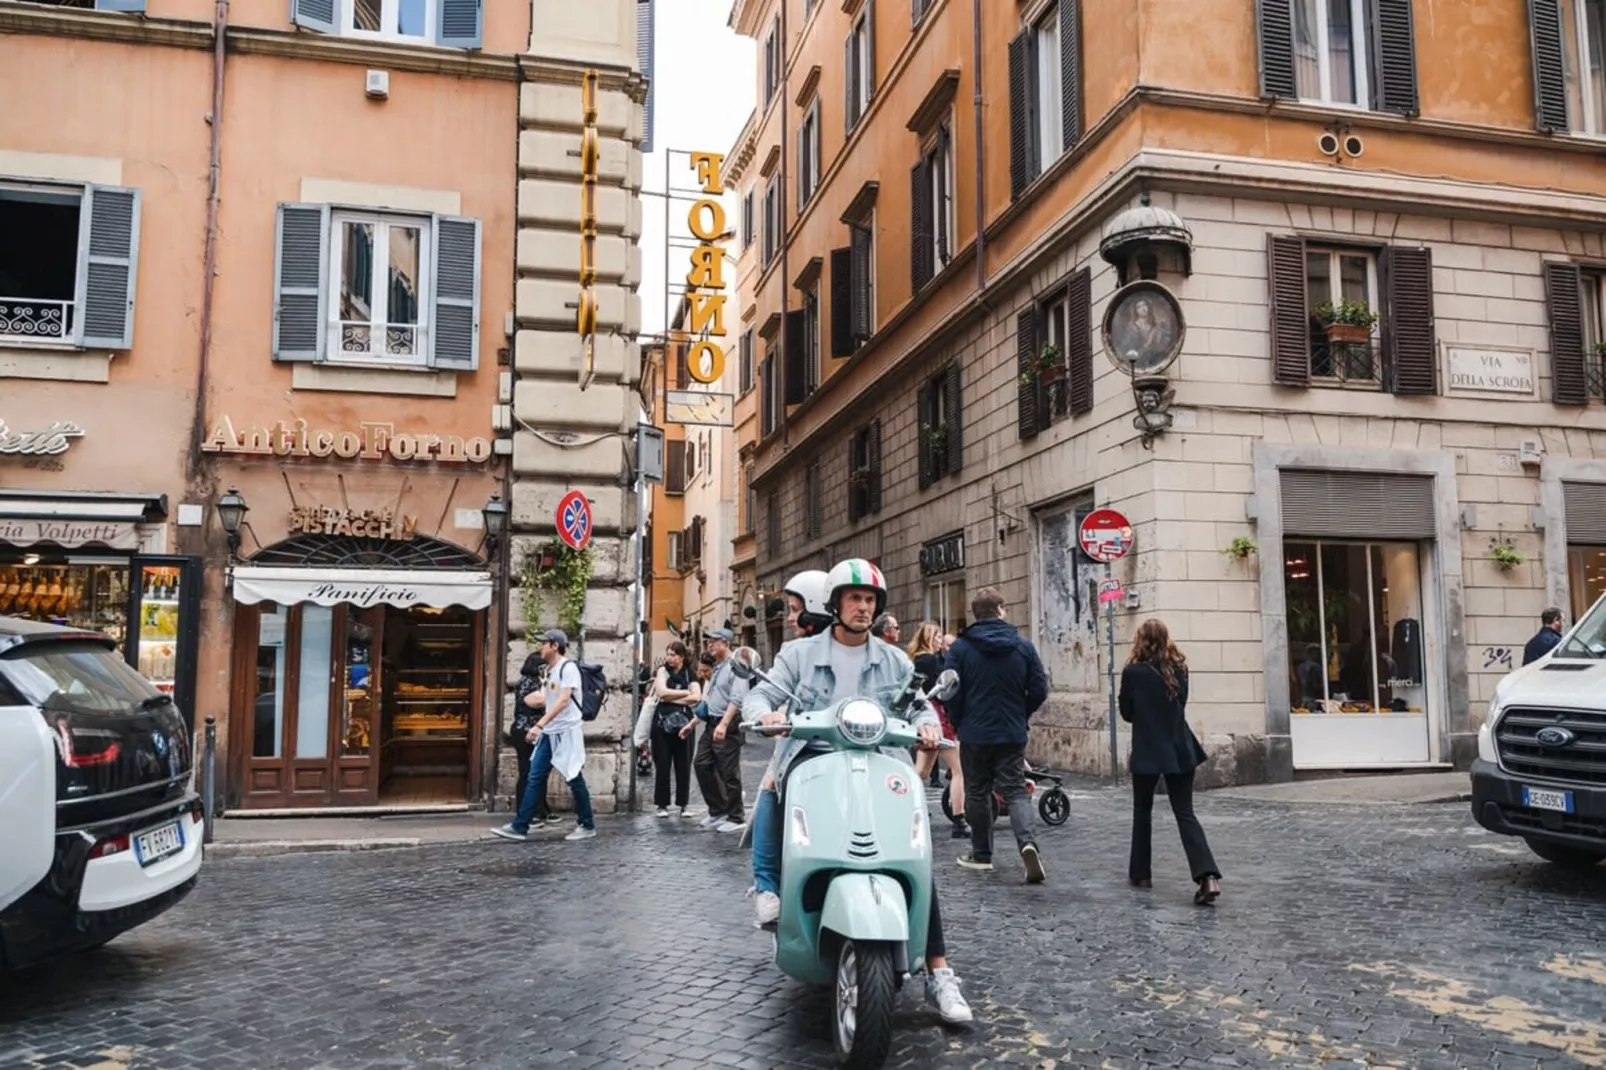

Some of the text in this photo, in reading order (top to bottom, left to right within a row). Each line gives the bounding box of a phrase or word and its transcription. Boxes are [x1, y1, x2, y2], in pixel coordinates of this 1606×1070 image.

[1480, 354, 1502, 368] VIA
[1450, 372, 1532, 389] DELLA SCROFA
[37, 522, 119, 544] Volpetti
[307, 583, 421, 606] Panificio
[1387, 676, 1414, 688] merci
